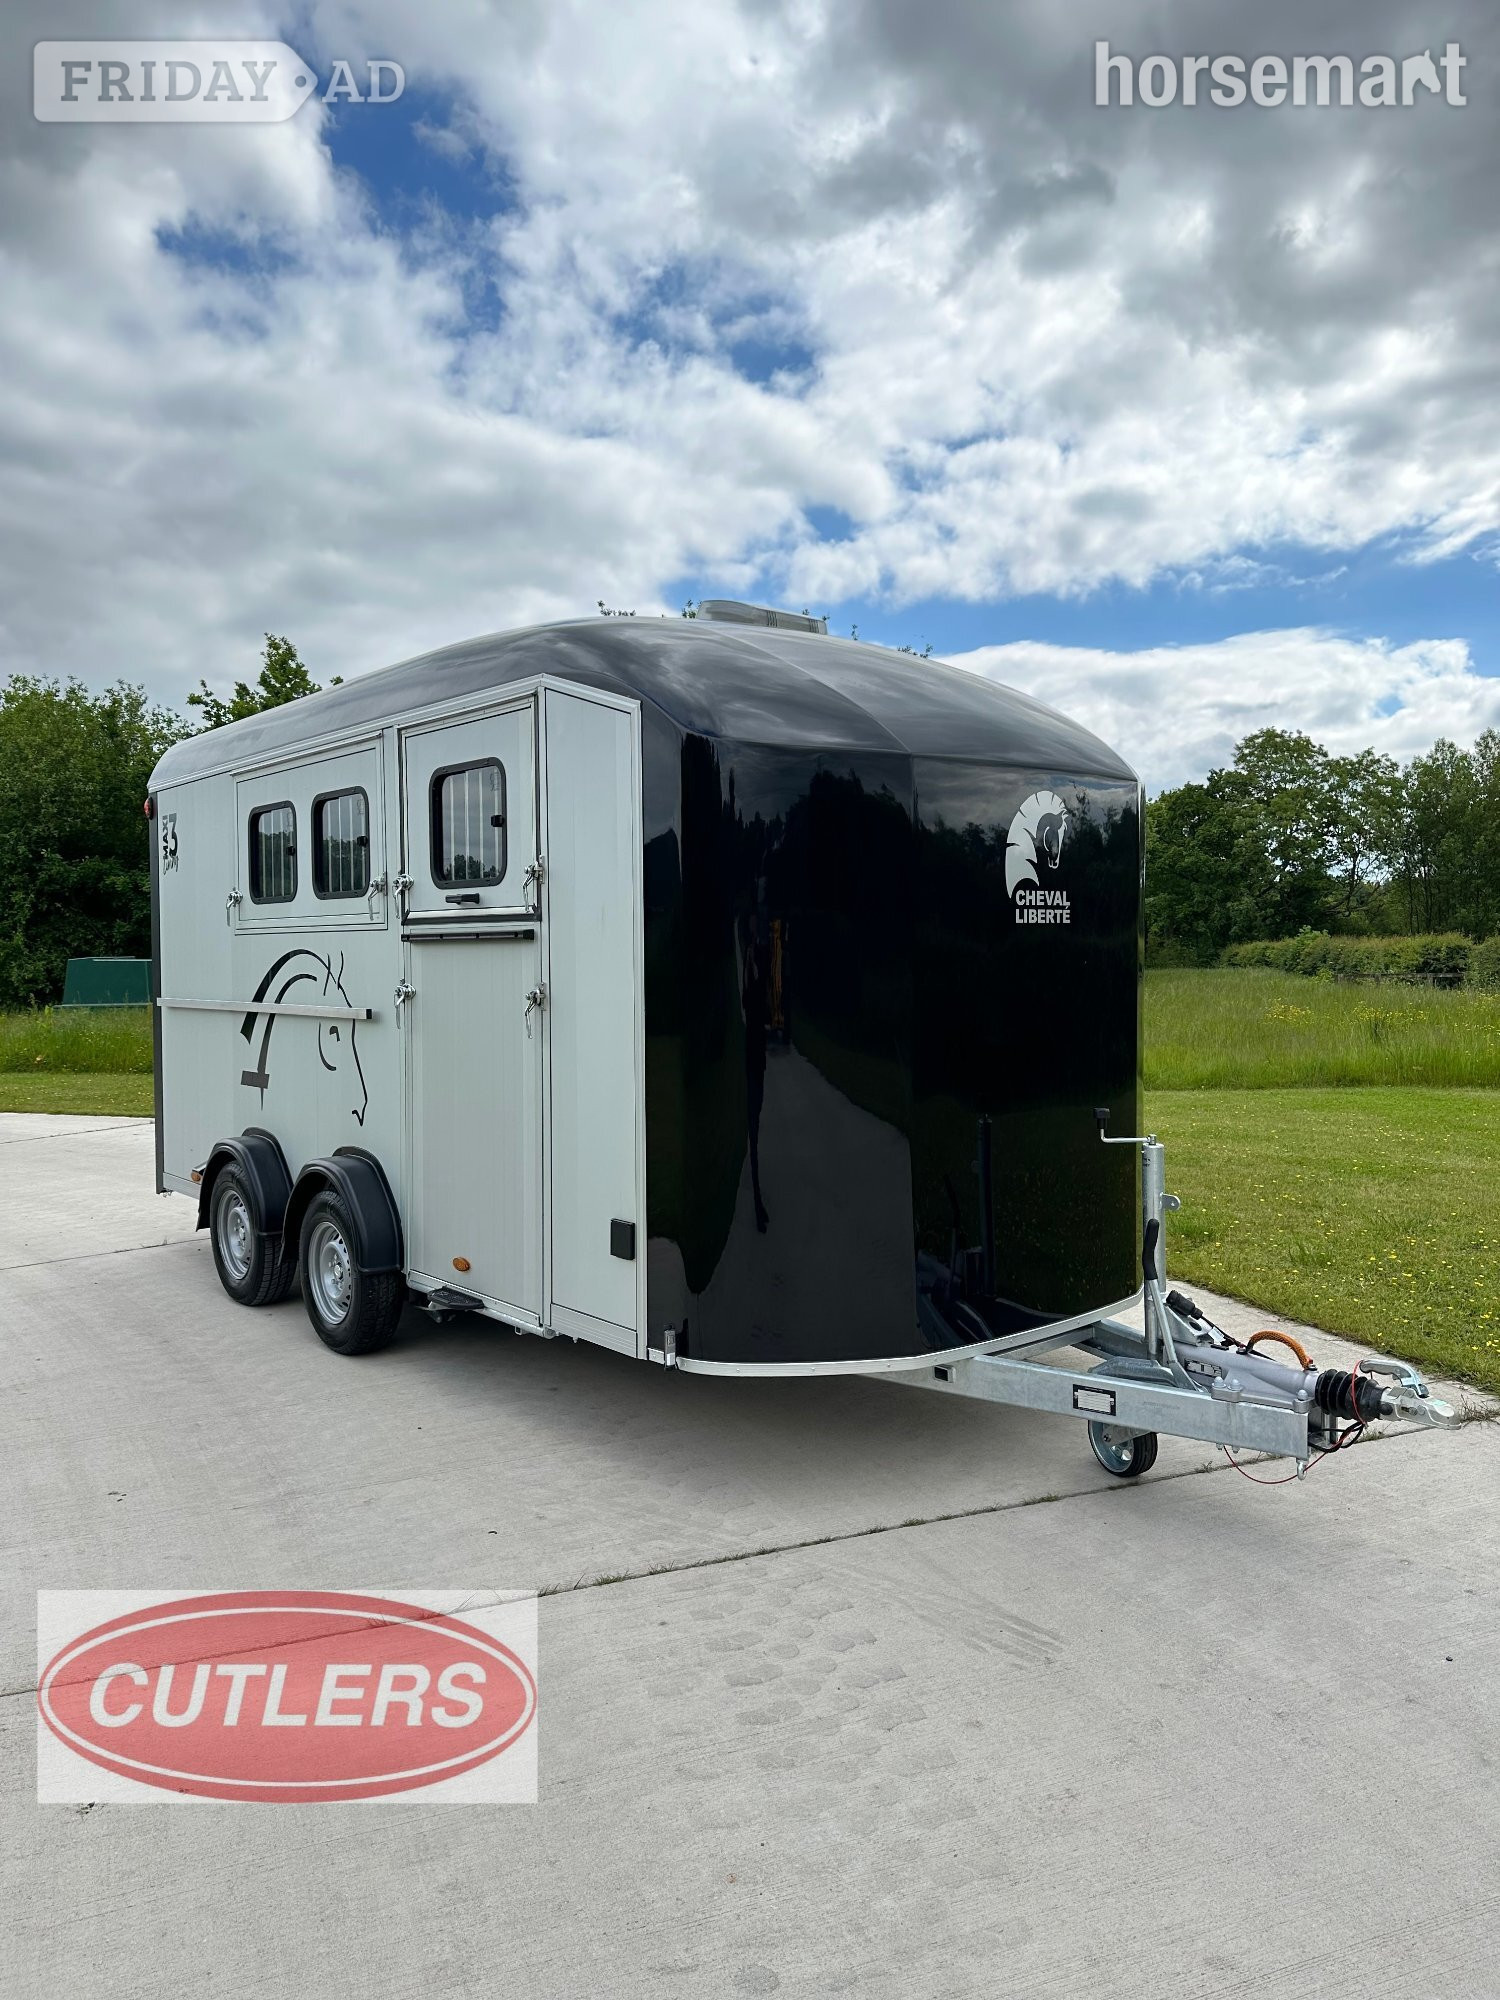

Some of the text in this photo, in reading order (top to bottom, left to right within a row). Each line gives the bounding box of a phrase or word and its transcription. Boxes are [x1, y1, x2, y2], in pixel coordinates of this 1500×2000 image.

[168, 812, 178, 857] 3
[1015, 889, 1071, 906] CHEVAL
[1015, 906, 1071, 924] LIBERTÉ
